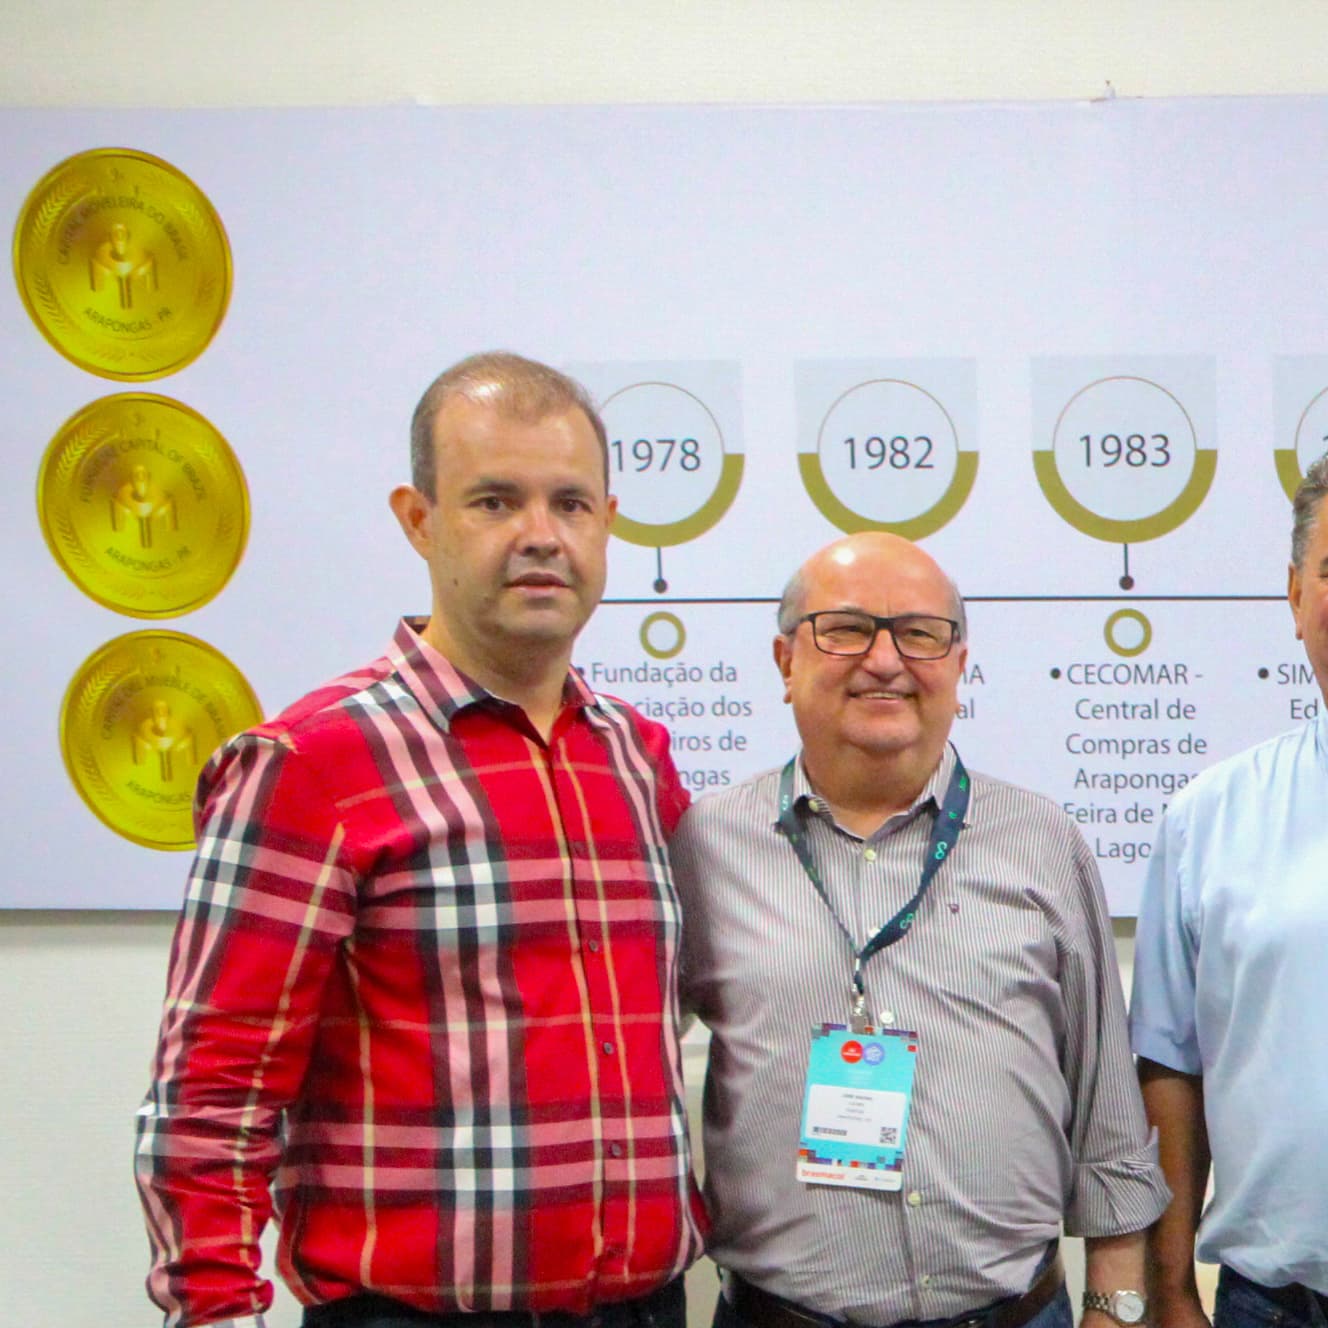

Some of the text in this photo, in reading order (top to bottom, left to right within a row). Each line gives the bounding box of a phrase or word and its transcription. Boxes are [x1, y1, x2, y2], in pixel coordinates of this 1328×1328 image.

[610, 438, 701, 473] 1978
[843, 435, 934, 470] 1982
[1078, 432, 1172, 469] 1983
[591, 661, 737, 687] Fundação da
[1066, 663, 1188, 685] CECOMAR
[1277, 663, 1314, 685] SIM
[635, 695, 752, 721] ciação dos
[1075, 698, 1196, 720] Central de
[1290, 698, 1319, 720] Ed
[718, 730, 747, 751] de
[1065, 733, 1207, 760] Compras de
[1063, 802, 1117, 824] Feira
[1124, 801, 1154, 824] de
